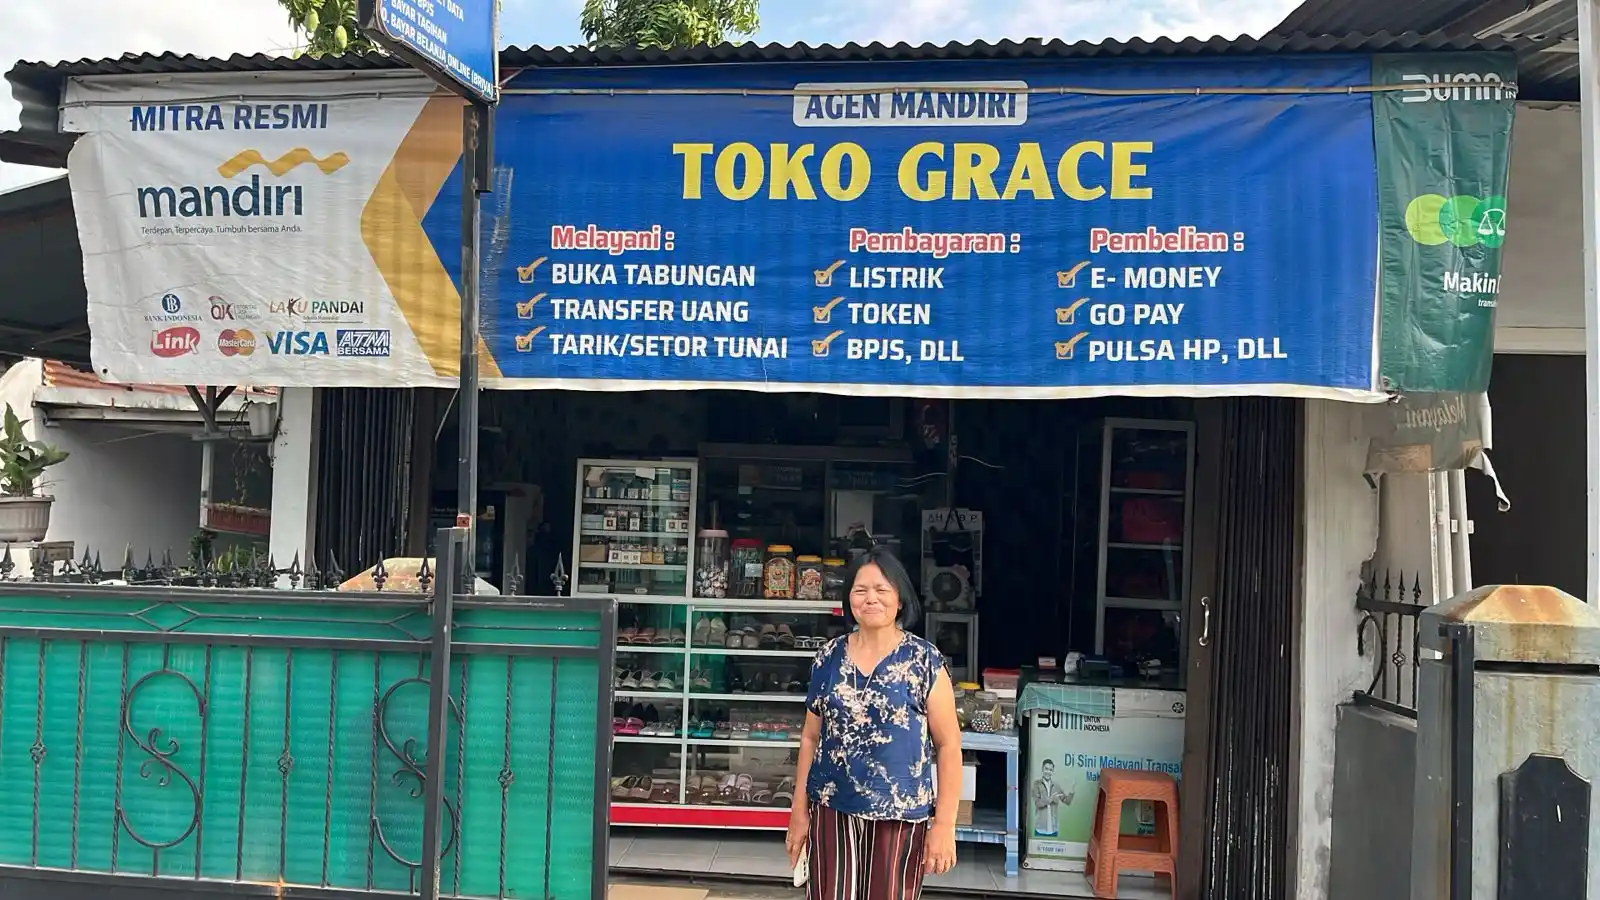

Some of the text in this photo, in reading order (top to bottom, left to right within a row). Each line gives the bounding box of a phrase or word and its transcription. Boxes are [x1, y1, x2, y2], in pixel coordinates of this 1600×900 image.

[391, 0, 447, 45] BAYAR TAGIHAN
[391, 13, 416, 41] BAYAR
[416, 31, 446, 63] BELANJA
[447, 52, 471, 79] ONLINE
[131, 103, 328, 131] MITRA RESMI
[804, 91, 1017, 119] AGEN MANDIRI
[672, 140, 1153, 202] TOKO GRACE
[138, 174, 303, 218] mandiri
[215, 225, 247, 233] Tumbuh
[247, 225, 279, 233] bersama
[552, 263, 756, 287] BUKA TABUNGAN
[850, 267, 945, 289] LISTRIK
[1124, 265, 1222, 289] MONEY
[144, 314, 203, 322] BANK INDONESIA
[269, 297, 308, 318] LAKU
[312, 301, 364, 314] PANDAI
[550, 298, 749, 323] TRANSFER UANG
[847, 303, 931, 325] TOKEN
[1089, 303, 1184, 326] GO PAY
[151, 329, 199, 355] Link
[219, 338, 255, 348] MasterCard
[265, 331, 330, 355] VISA
[337, 347, 389, 355] BERSAMA
[338, 331, 389, 347] ATM
[549, 333, 788, 359] TARIK/SETOR TUNAI
[847, 338, 965, 364] BPJS, DLL
[1088, 336, 1288, 364] PULSA HP, DLL
[1083, 724, 1110, 732] INDONESIA
[1064, 752, 1075, 767] Di
[1077, 754, 1097, 768] Sini
